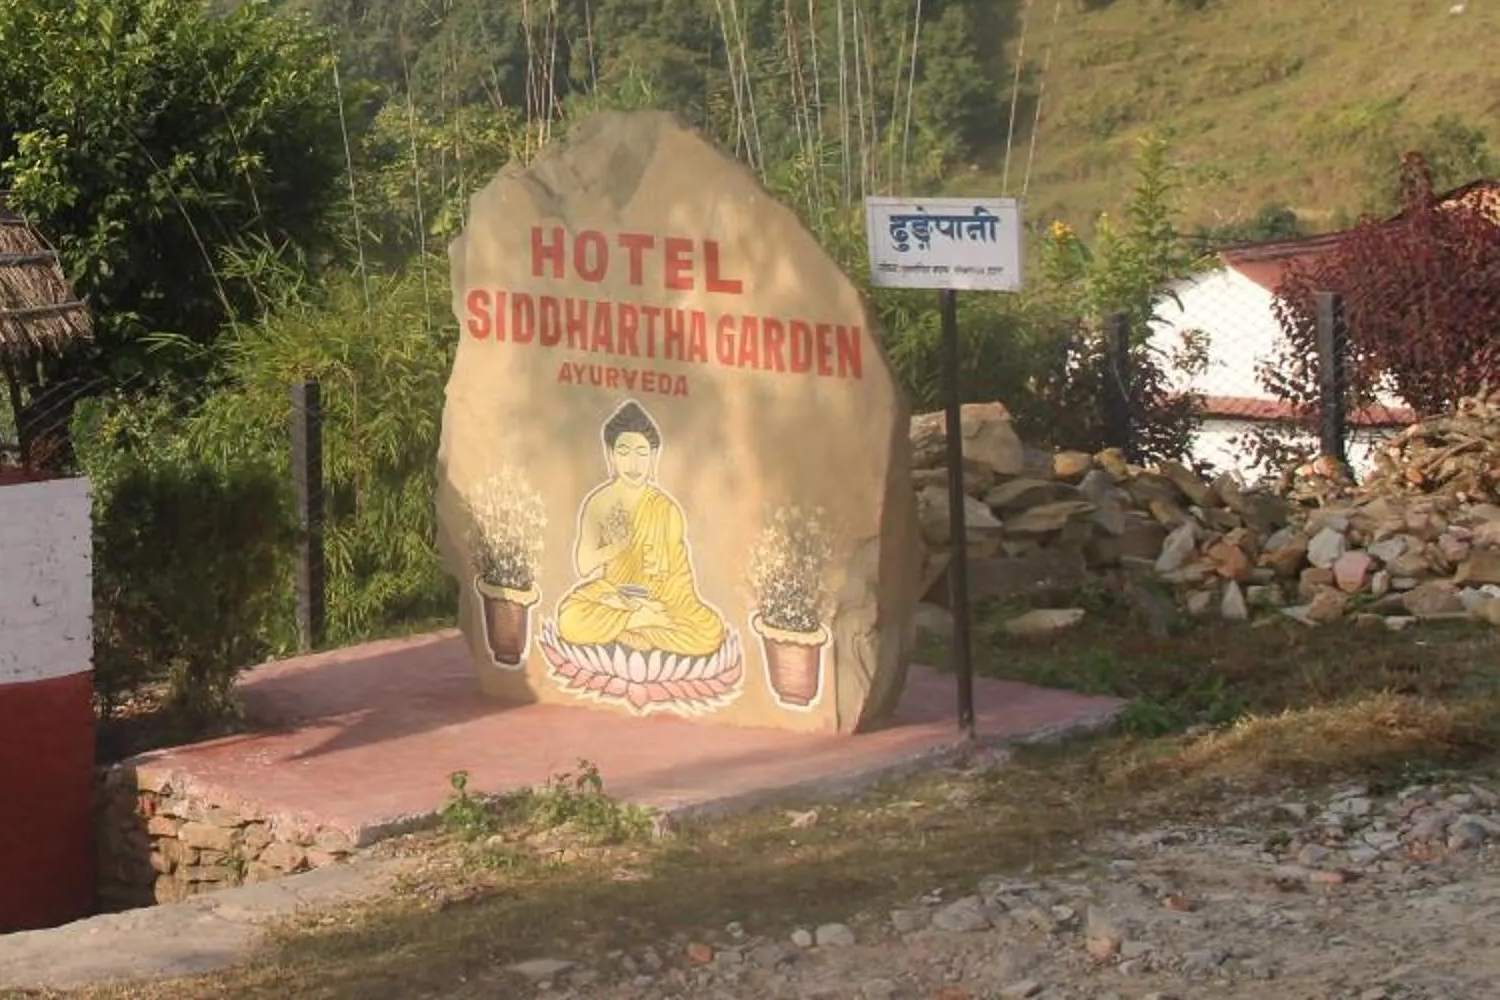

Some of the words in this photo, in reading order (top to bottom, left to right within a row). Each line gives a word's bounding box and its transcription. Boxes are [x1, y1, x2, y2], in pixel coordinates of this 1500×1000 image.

[530, 226, 743, 295] HOTEL
[466, 288, 709, 364] SIDDHARTHA
[715, 312, 864, 380] GARDEN
[557, 361, 690, 397] AYURVEDA
